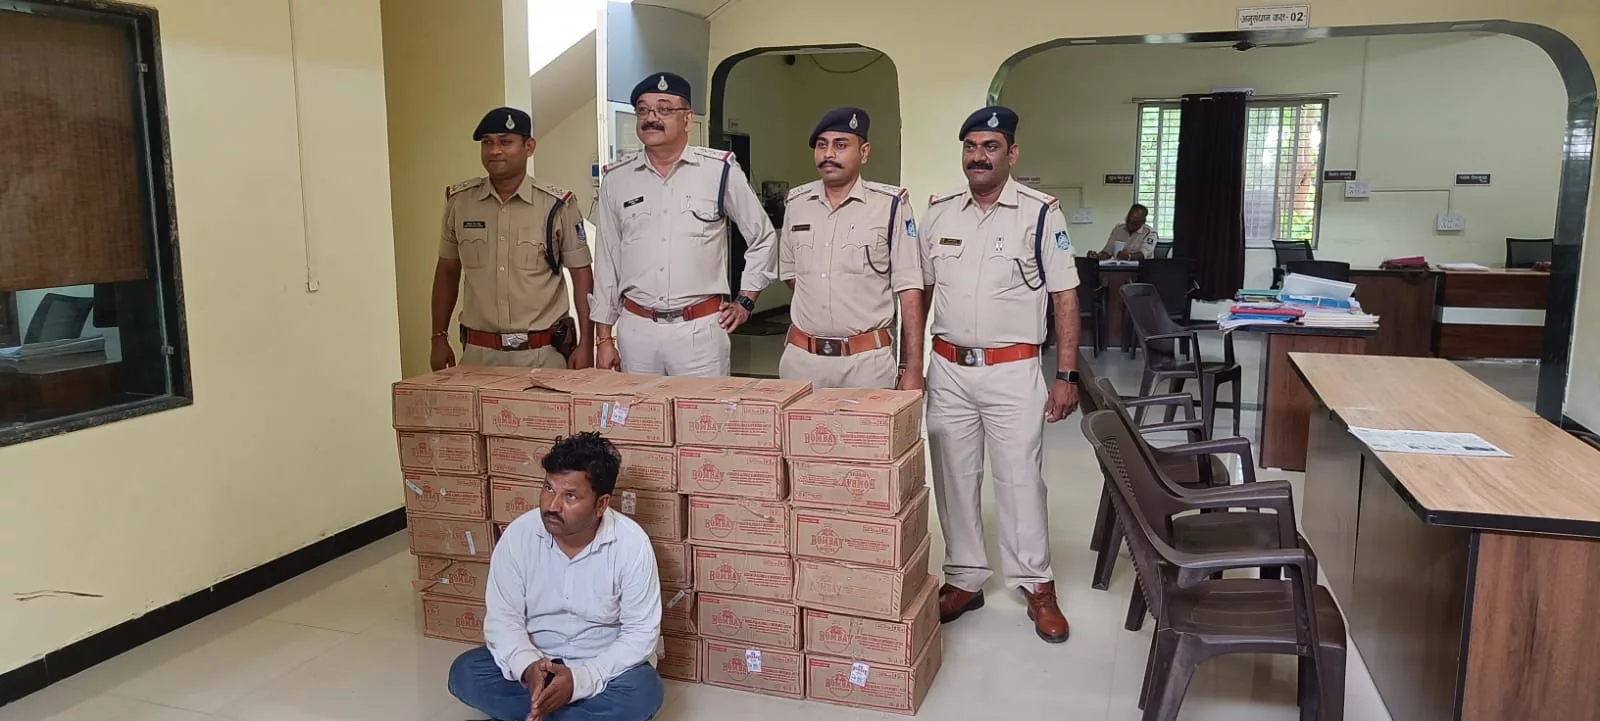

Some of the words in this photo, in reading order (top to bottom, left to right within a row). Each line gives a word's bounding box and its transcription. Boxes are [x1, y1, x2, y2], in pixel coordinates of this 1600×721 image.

[1290, 12, 1304, 22] 02
[689, 421, 723, 433] BOMBAY
[692, 469, 725, 482] BOMBAY
[841, 478, 876, 489] BOMBAY
[705, 519, 738, 531] BOMBAY
[811, 535, 845, 549] BOMBAY
[709, 570, 743, 581] BOMBAY
[712, 614, 743, 628] BOMBAY
[819, 630, 853, 645] BOMBAY
